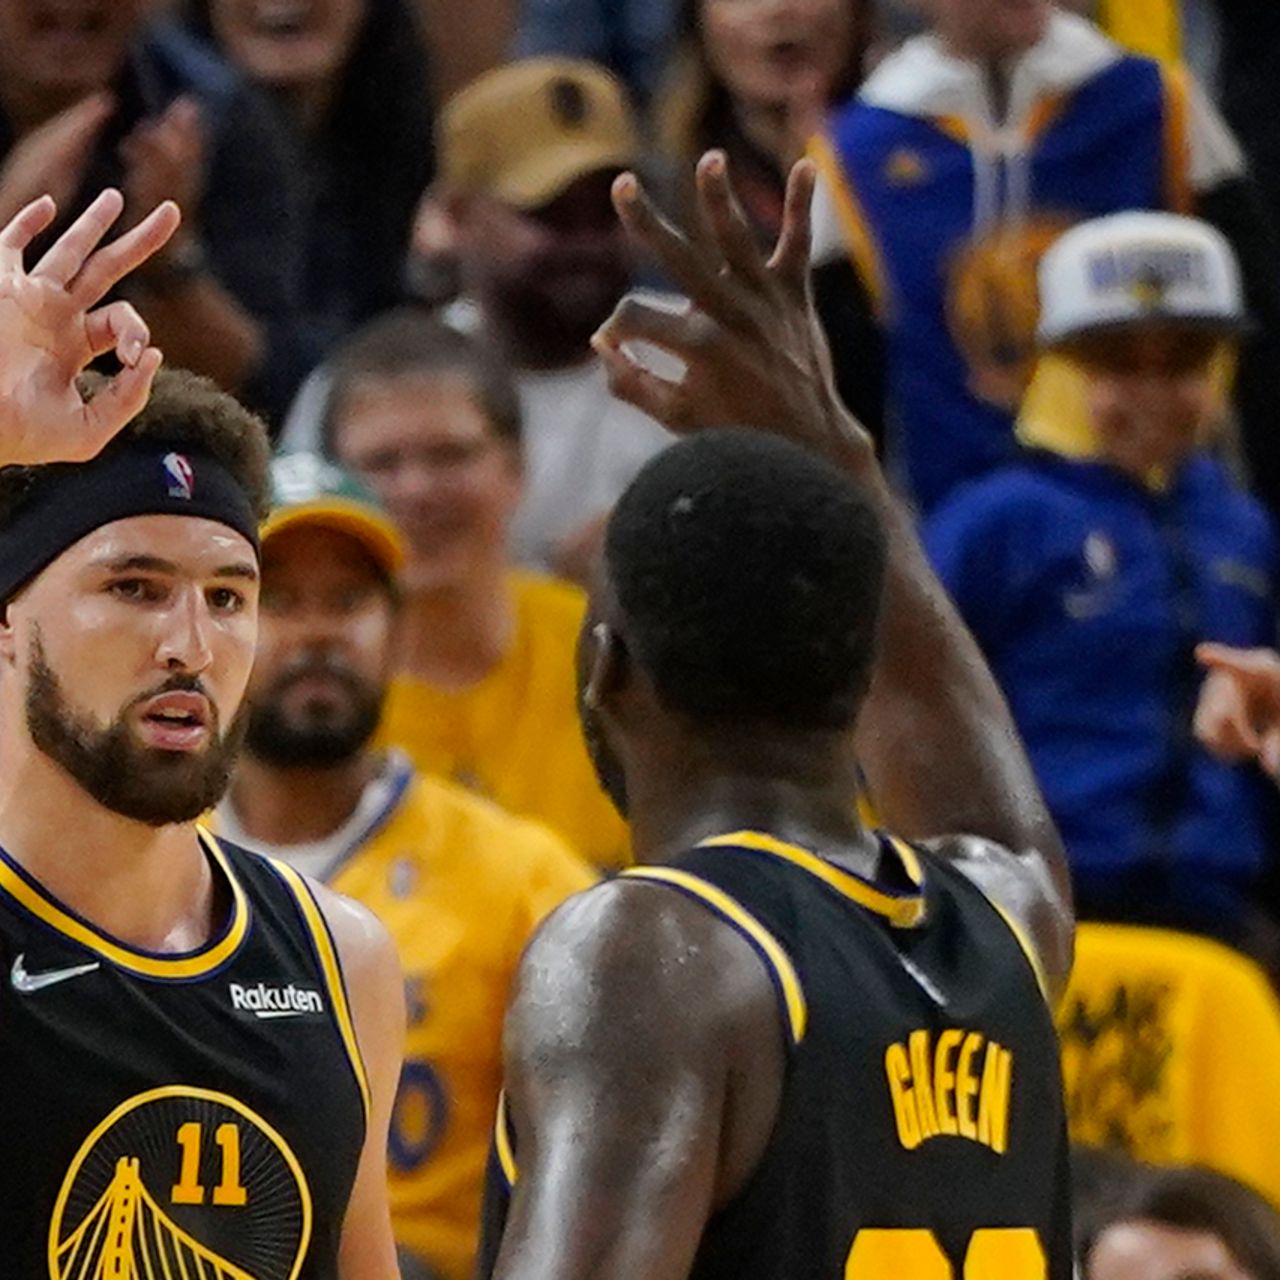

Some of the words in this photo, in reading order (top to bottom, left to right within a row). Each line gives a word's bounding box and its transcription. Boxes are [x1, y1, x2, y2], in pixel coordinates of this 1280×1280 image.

[229, 983, 323, 1013] Rakuten
[885, 1029, 1012, 1155] GREEN
[171, 1122, 247, 1205] 11
